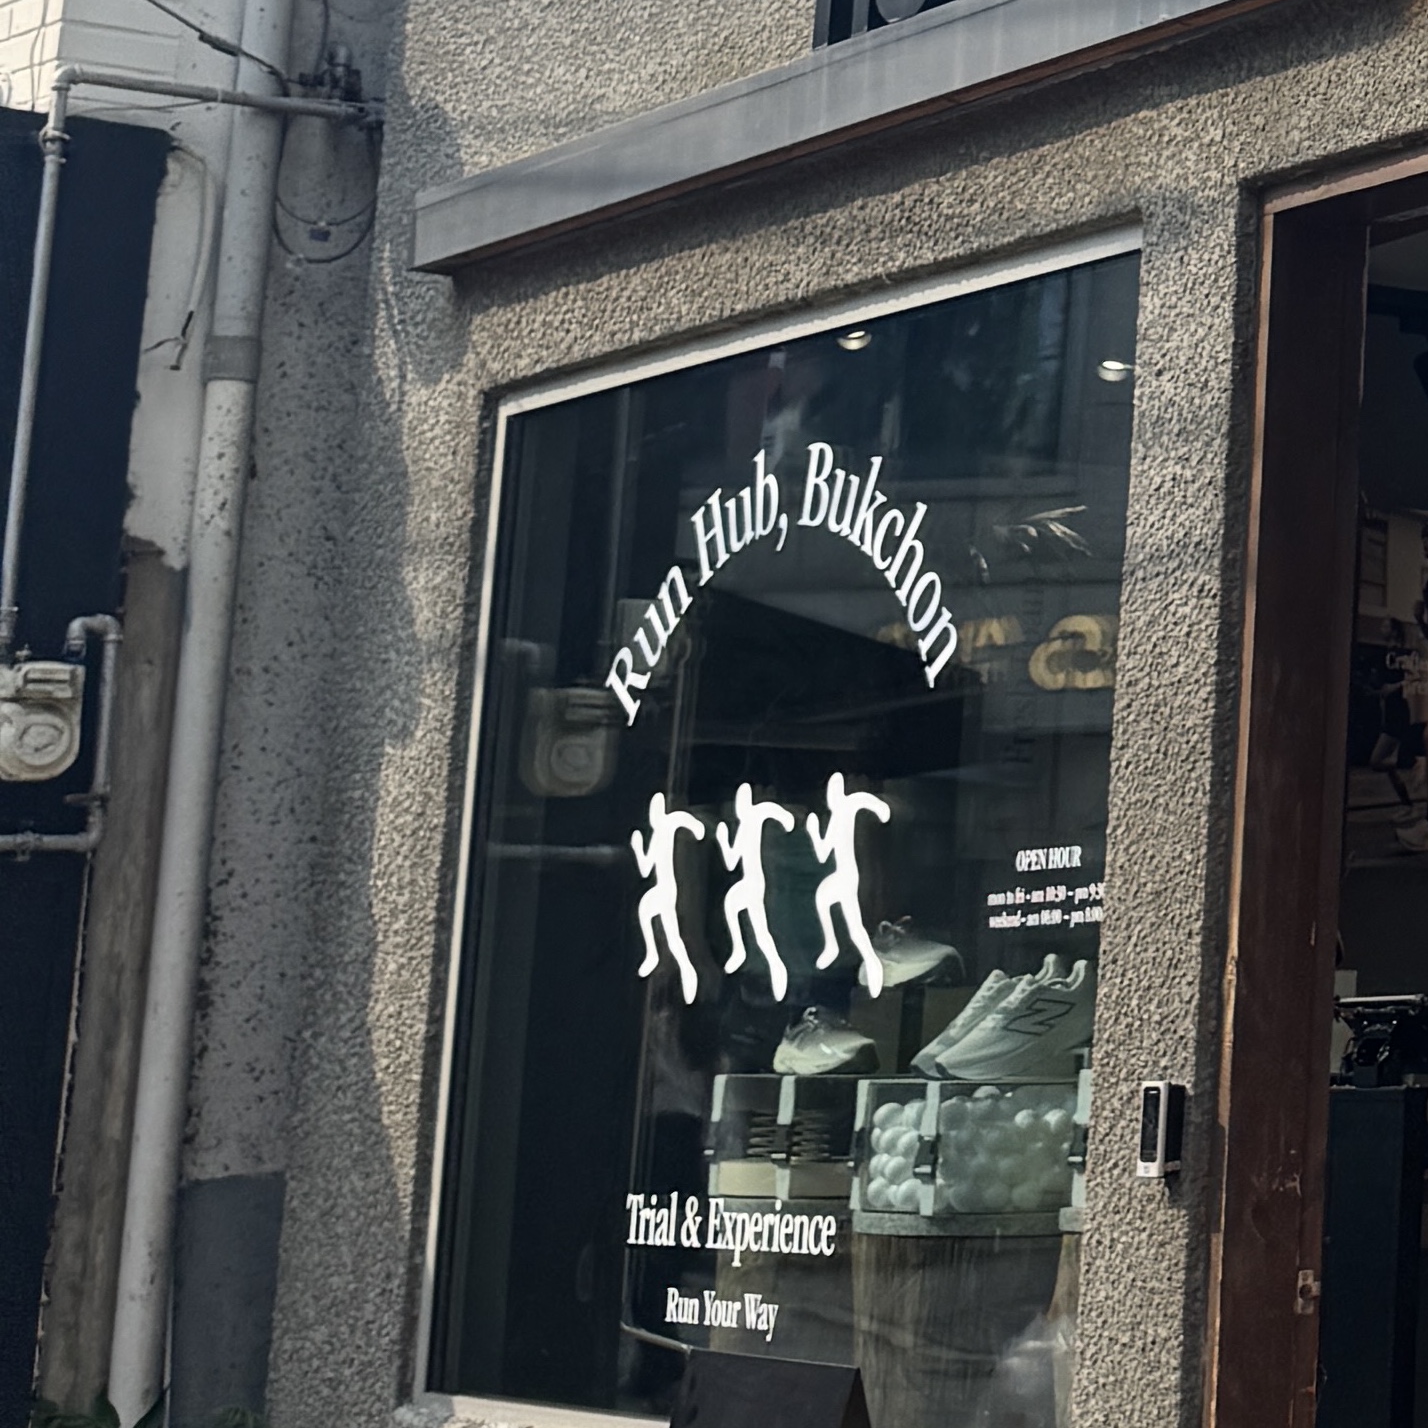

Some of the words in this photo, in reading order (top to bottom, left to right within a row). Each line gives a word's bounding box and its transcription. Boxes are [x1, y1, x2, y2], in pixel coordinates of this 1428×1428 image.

[605, 564, 694, 727] Run
[690, 448, 789, 587] Hub,
[797, 441, 958, 689] Bukchon
[1015, 847, 1048, 872] OPEN
[1047, 845, 1082, 870] HOUR
[626, 1190, 679, 1247] Trial
[680, 1195, 703, 1249] &
[704, 1197, 837, 1268] Experience
[664, 1287, 700, 1325] Run
[702, 1289, 742, 1329] Your
[743, 1292, 779, 1342] Way
